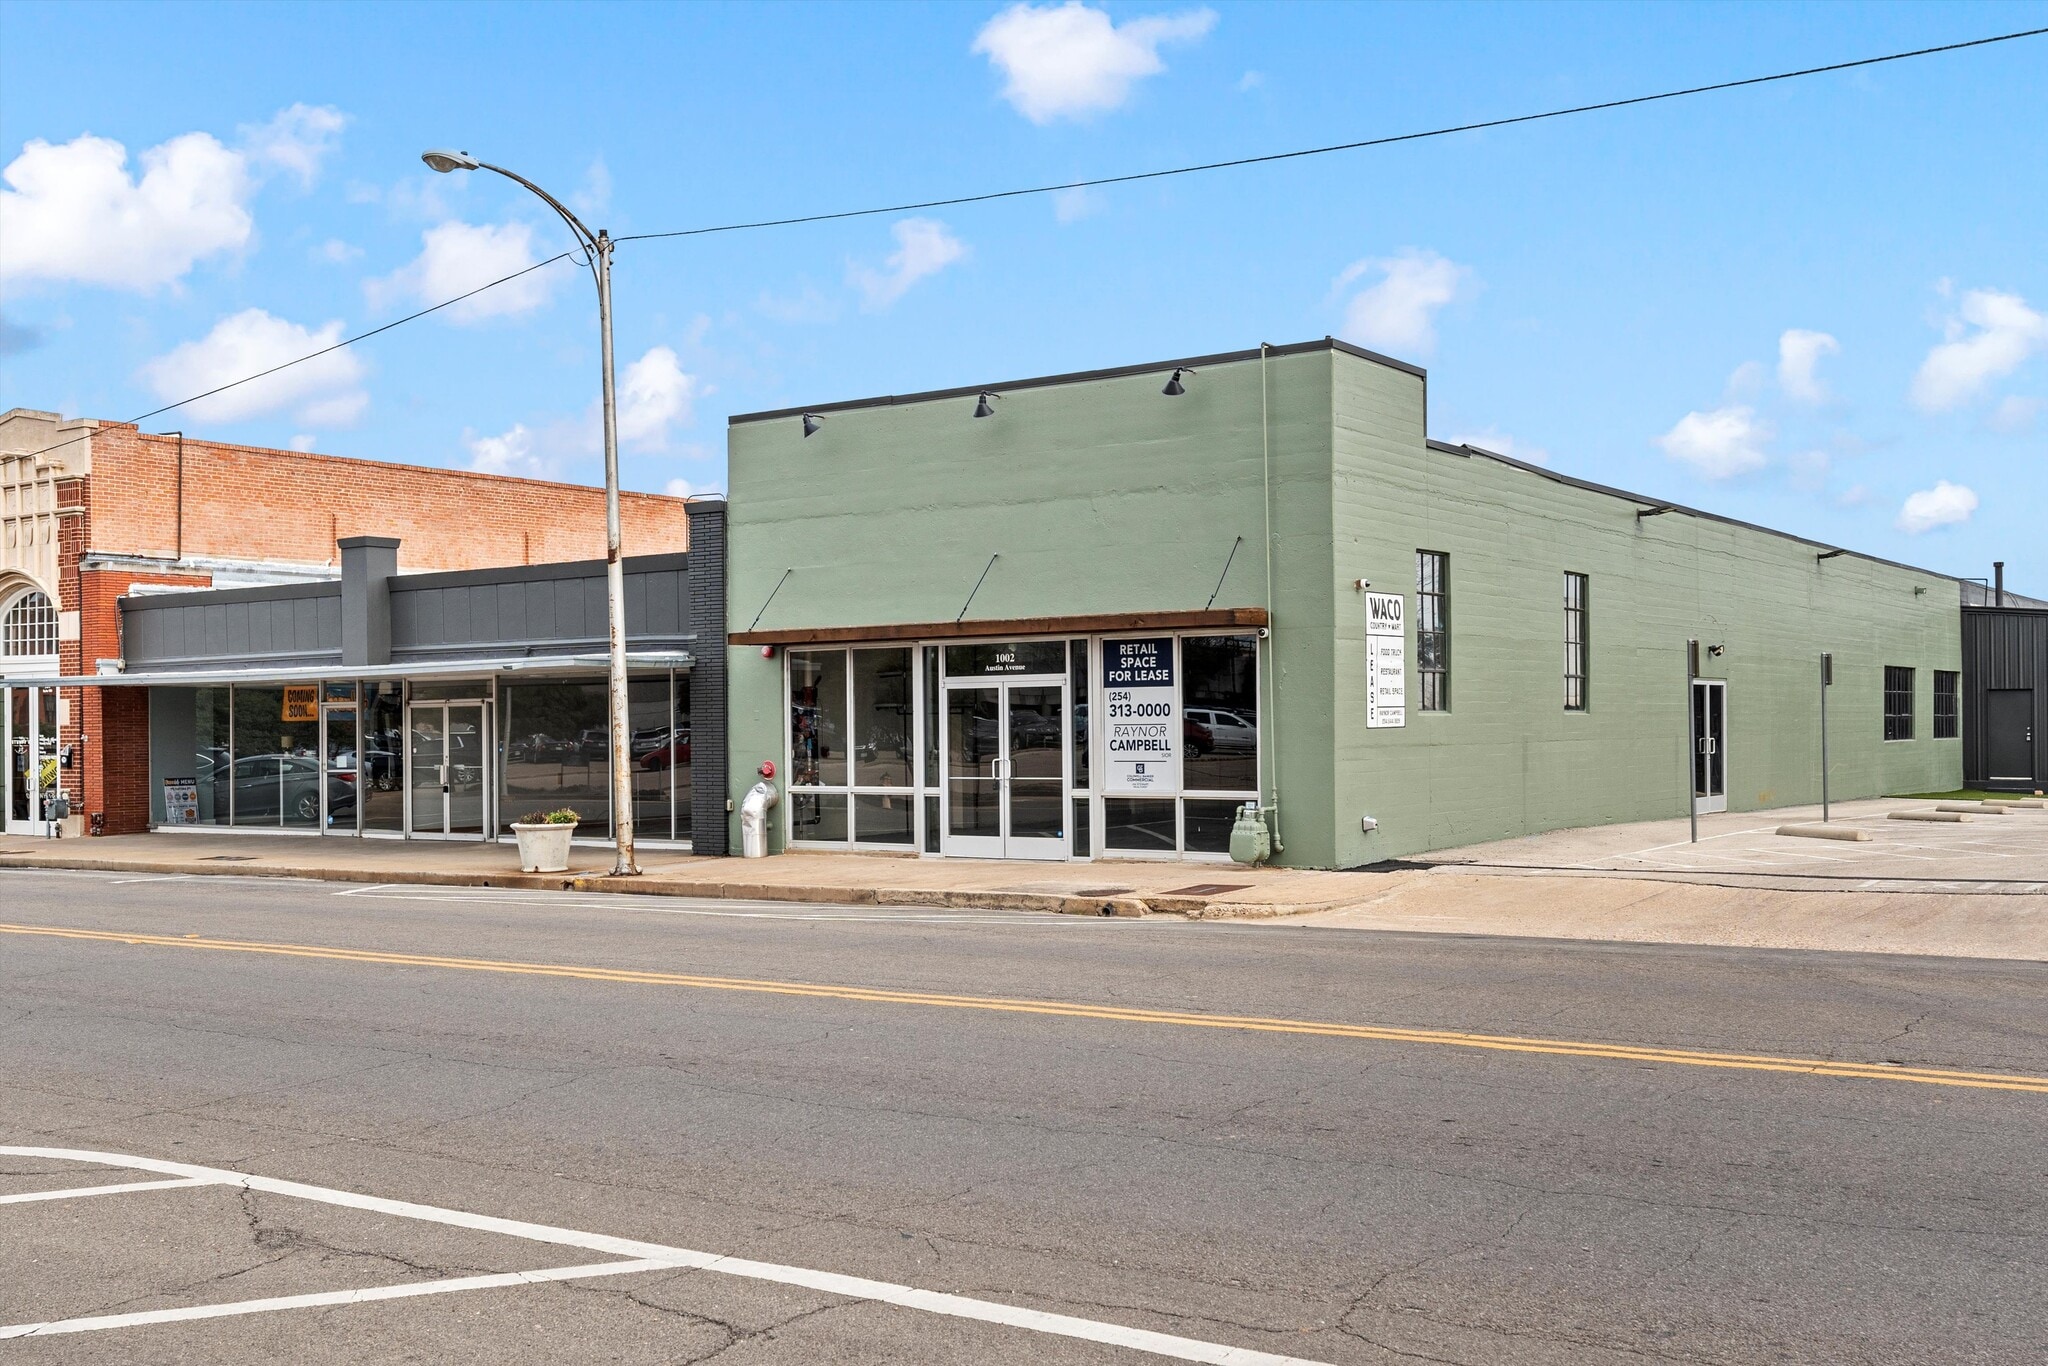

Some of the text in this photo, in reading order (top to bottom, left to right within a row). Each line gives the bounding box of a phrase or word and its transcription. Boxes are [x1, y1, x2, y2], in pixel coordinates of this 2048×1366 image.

[1369, 597, 1401, 621] WACO
[1119, 643, 1158, 655] RETAIL
[995, 653, 1015, 663] 1002
[1120, 656, 1157, 669] SPACE
[985, 664, 1004, 672] Austin
[1109, 669, 1169, 682] FOR LEASE
[288, 689, 315, 703] COMING
[1109, 691, 1131, 702] (254)
[288, 704, 315, 718] SOON...
[1109, 703, 1171, 717] 313-0000
[1113, 726, 1167, 737] RAYNOR
[1109, 739, 1171, 751] CAMPBELL
